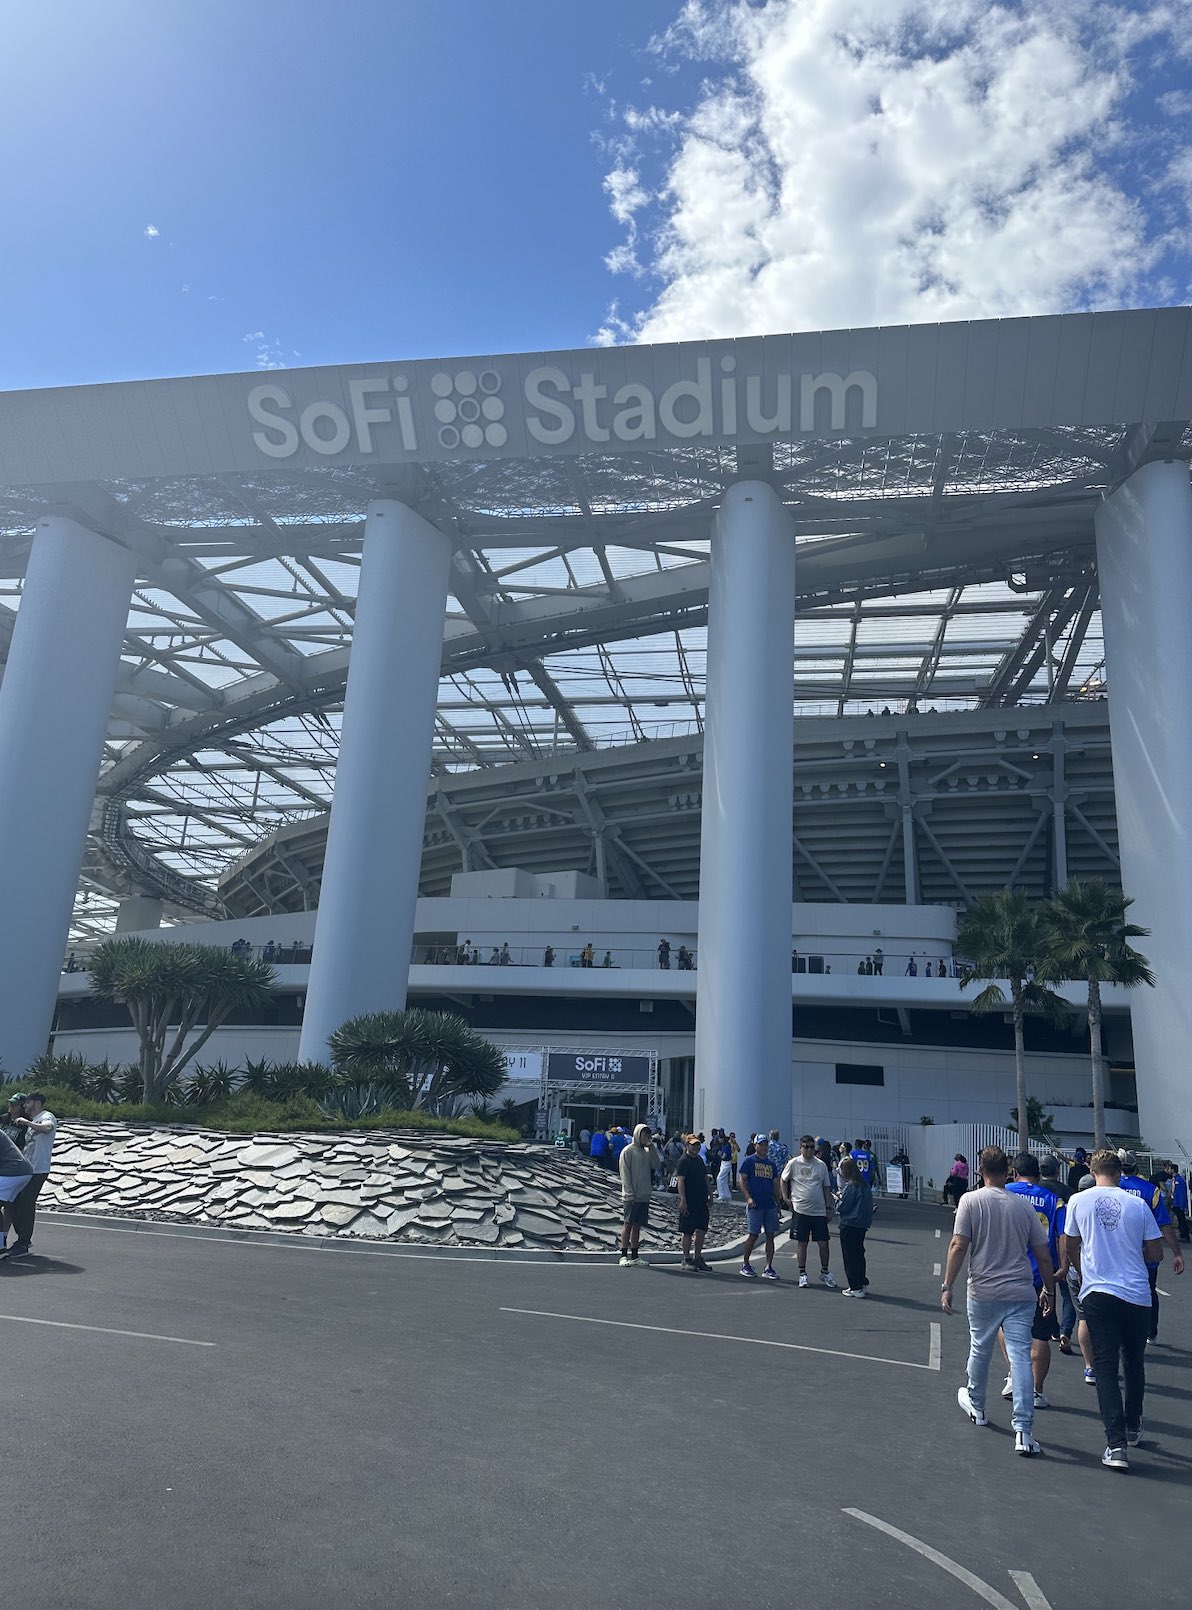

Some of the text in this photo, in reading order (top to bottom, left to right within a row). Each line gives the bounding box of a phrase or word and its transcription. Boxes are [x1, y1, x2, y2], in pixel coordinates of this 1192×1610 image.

[246, 354, 879, 458] SoFi Stadium
[575, 1056, 606, 1071] SoFi
[856, 1159, 870, 1172] 99
[1015, 1192, 1045, 1207] ONALD
